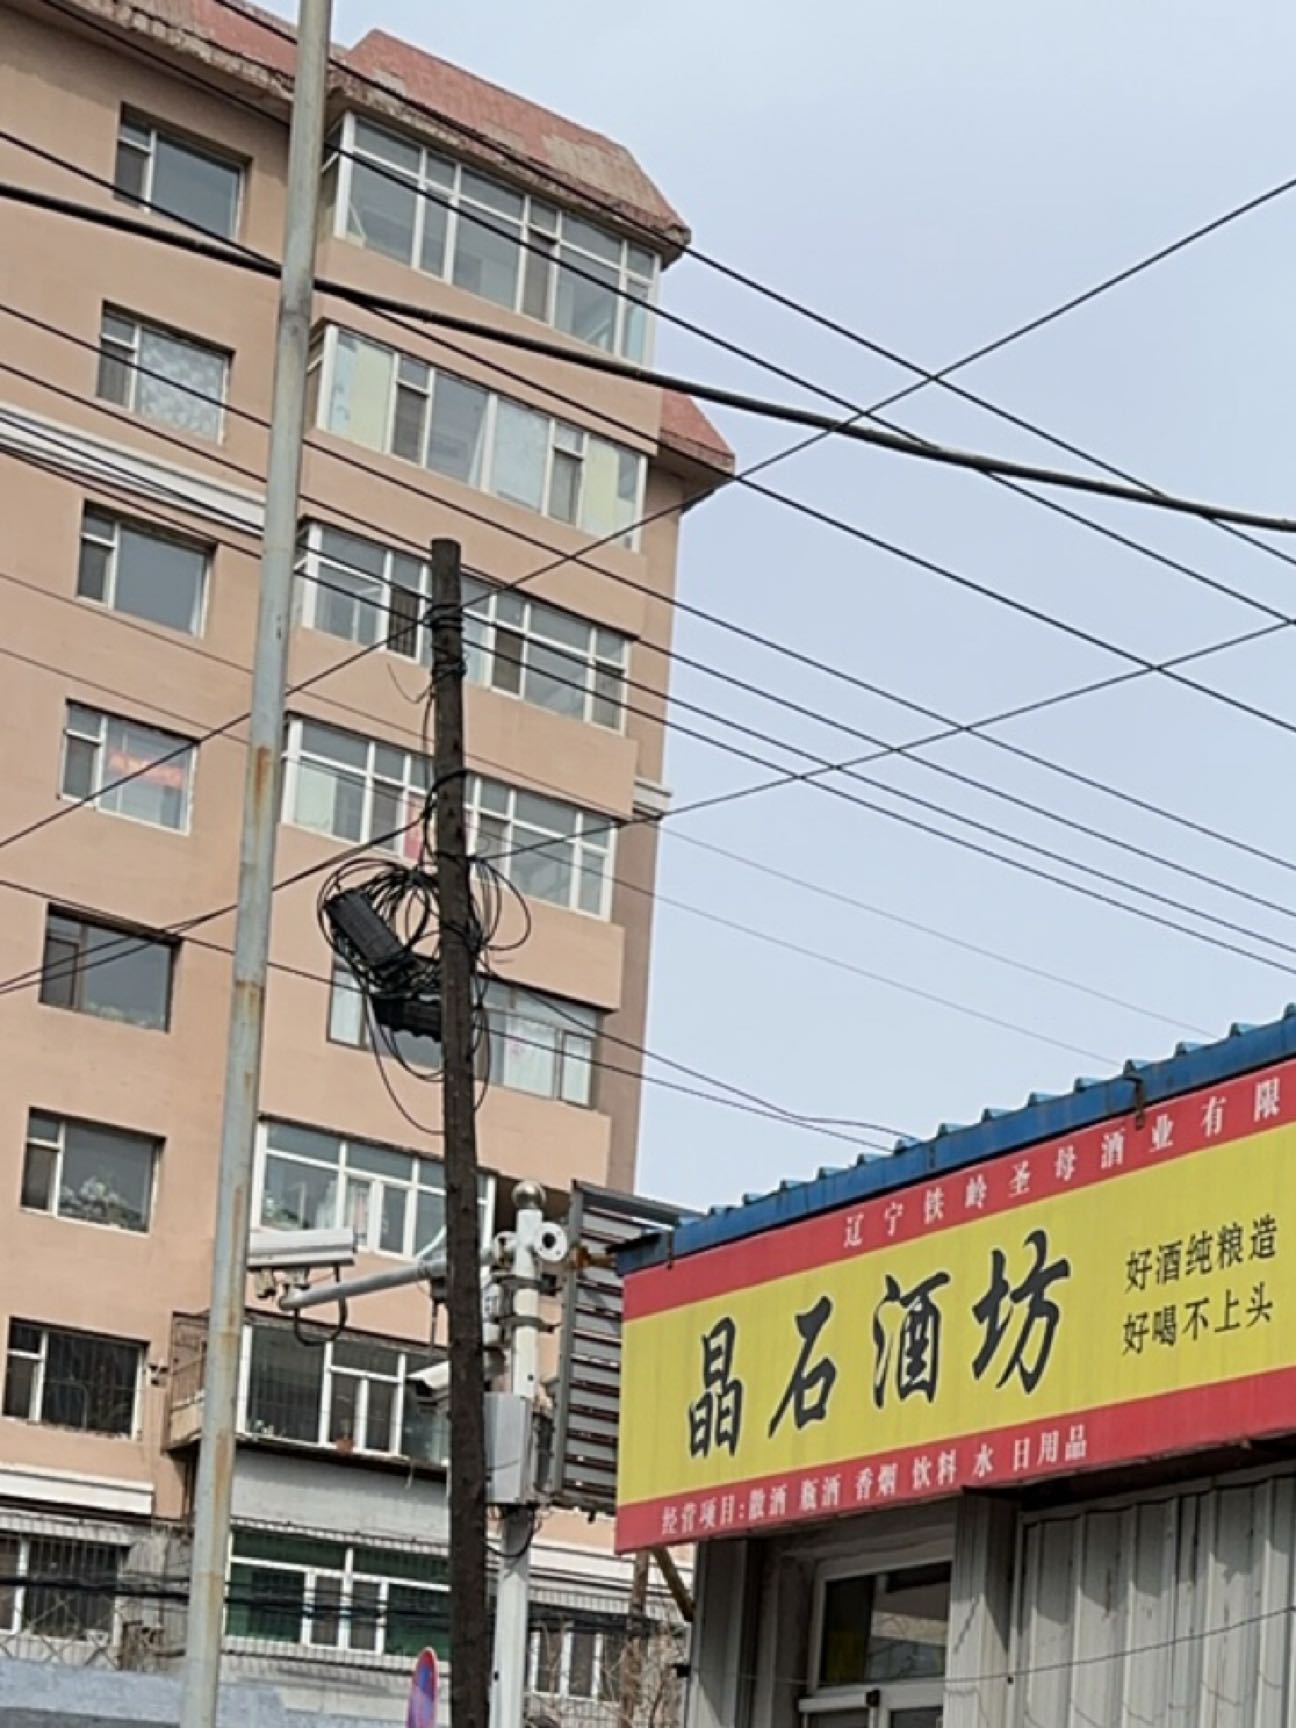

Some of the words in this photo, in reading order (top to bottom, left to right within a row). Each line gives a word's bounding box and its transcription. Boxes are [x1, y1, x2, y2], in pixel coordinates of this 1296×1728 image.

[1124, 1212, 1278, 1294] 好酒纯粮造
[687, 1229, 1071, 1460] 晶石酒坊
[1121, 1280, 1274, 1356] 好喝不上头
[855, 1463, 898, 1500] 香烟
[912, 1449, 958, 1491] 饮料
[973, 1444, 994, 1479] 水
[1013, 1424, 1088, 1472] 日用品
